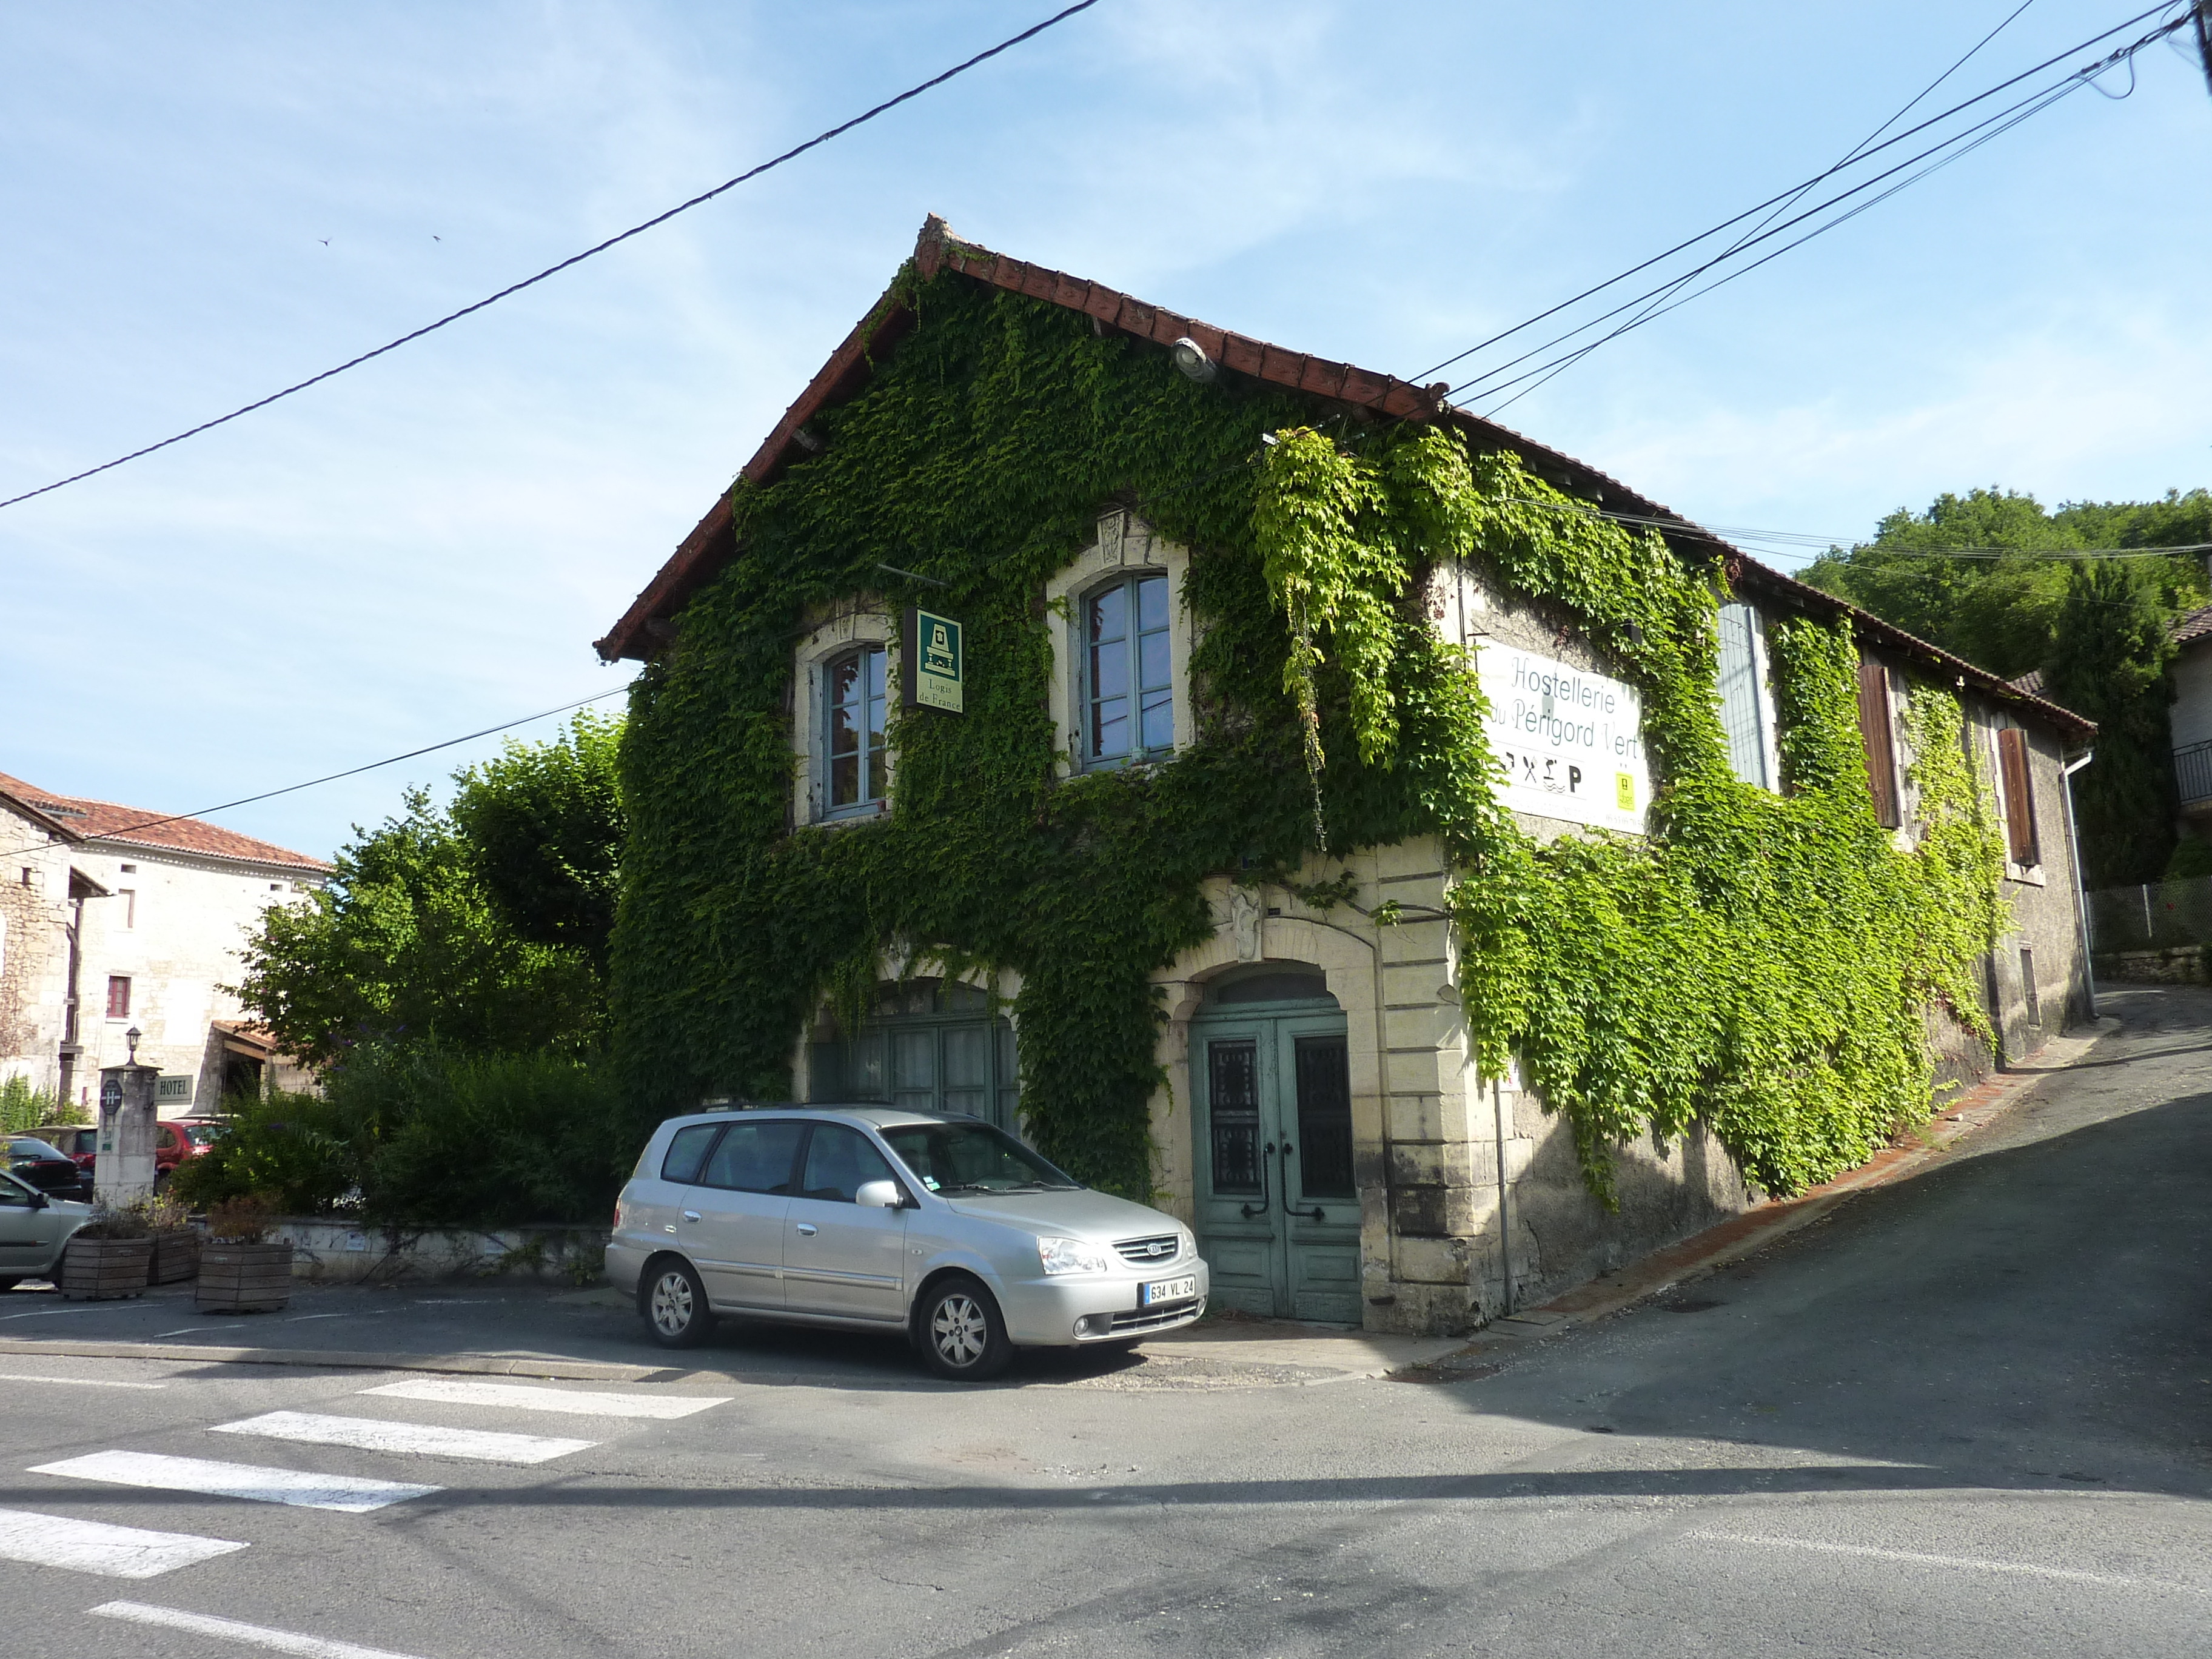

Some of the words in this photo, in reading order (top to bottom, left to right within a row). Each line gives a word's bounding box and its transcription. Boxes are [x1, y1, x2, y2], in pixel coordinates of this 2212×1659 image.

[929, 679, 952, 694] Logis
[1512, 657, 1615, 714] Hostellerie
[919, 692, 929, 702] de
[932, 692, 960, 710] France
[1511, 698, 1594, 746] Périgord
[1601, 721, 1638, 759] Vert
[159, 1079, 187, 1095] HOTEL
[107, 1091, 115, 1105] H
[1151, 1284, 1166, 1299] 634
[1170, 1281, 1181, 1296] VL
[1184, 1279, 1194, 1294] 24
